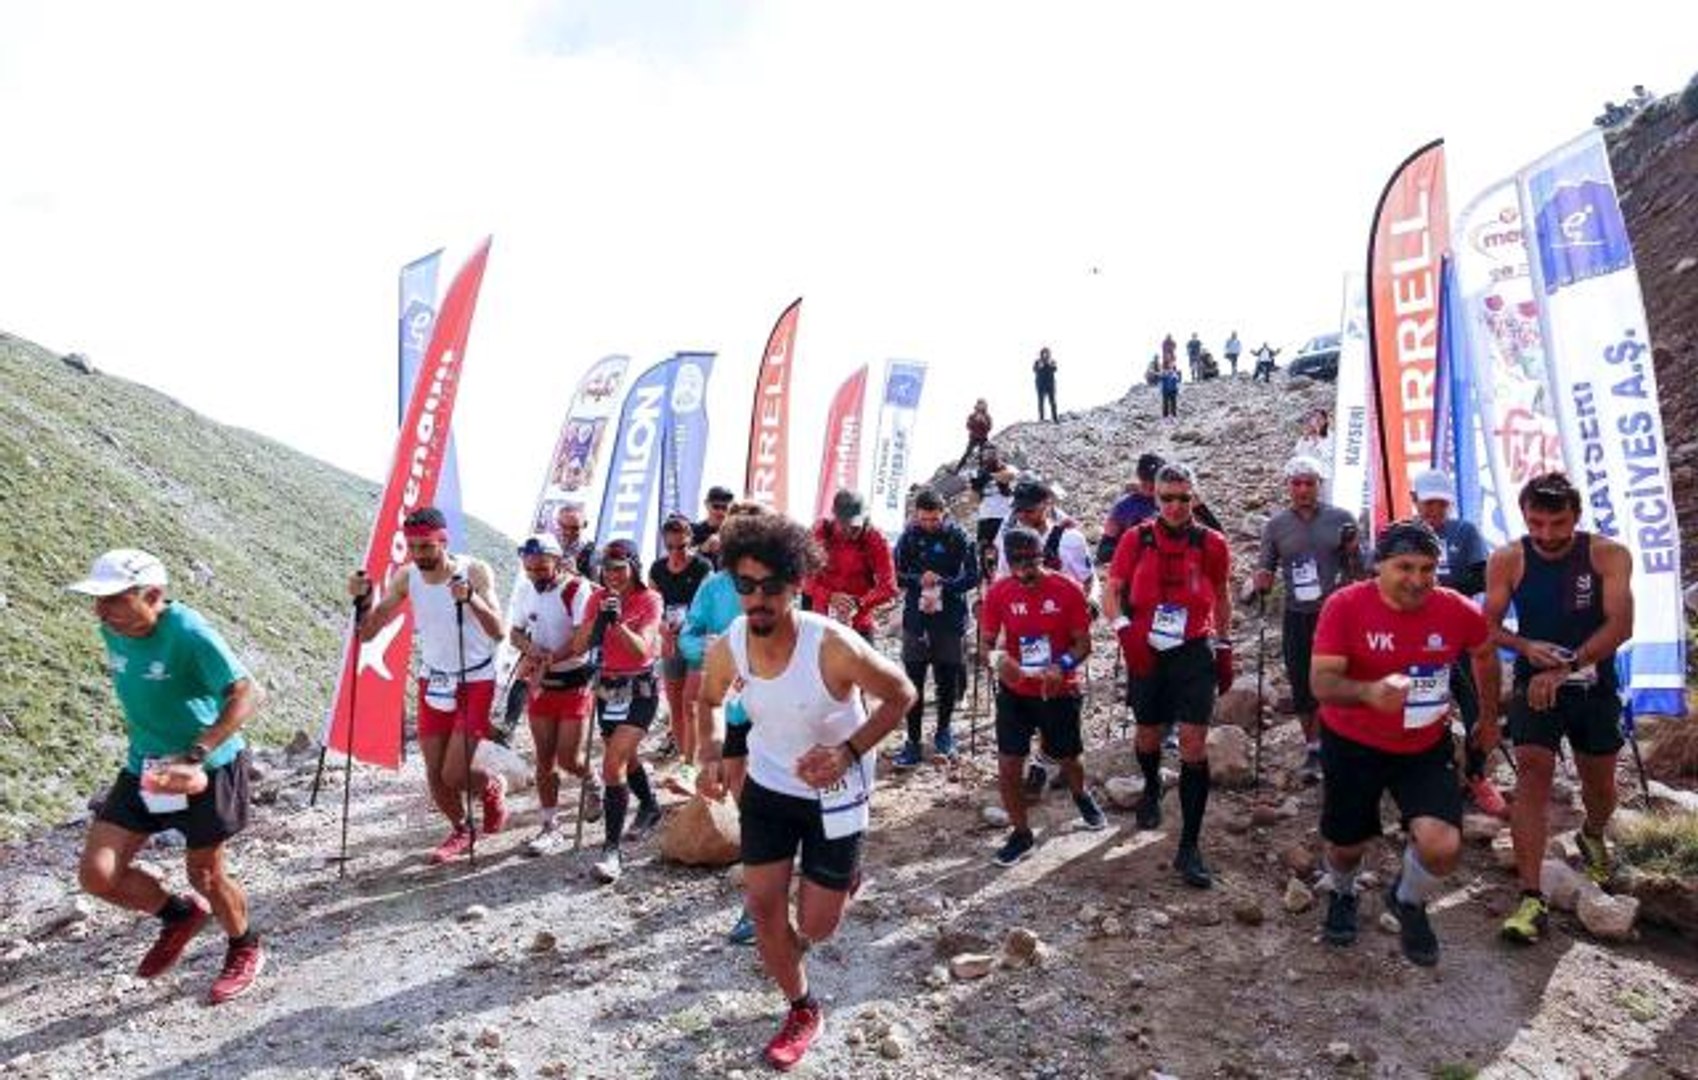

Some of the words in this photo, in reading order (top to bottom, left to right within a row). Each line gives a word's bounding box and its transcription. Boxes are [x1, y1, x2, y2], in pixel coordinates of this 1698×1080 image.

[1390, 189, 1437, 491] ERRELL
[752, 338, 788, 511] RRELL
[1009, 602, 1029, 615] VK
[1366, 631, 1396, 651] VK
